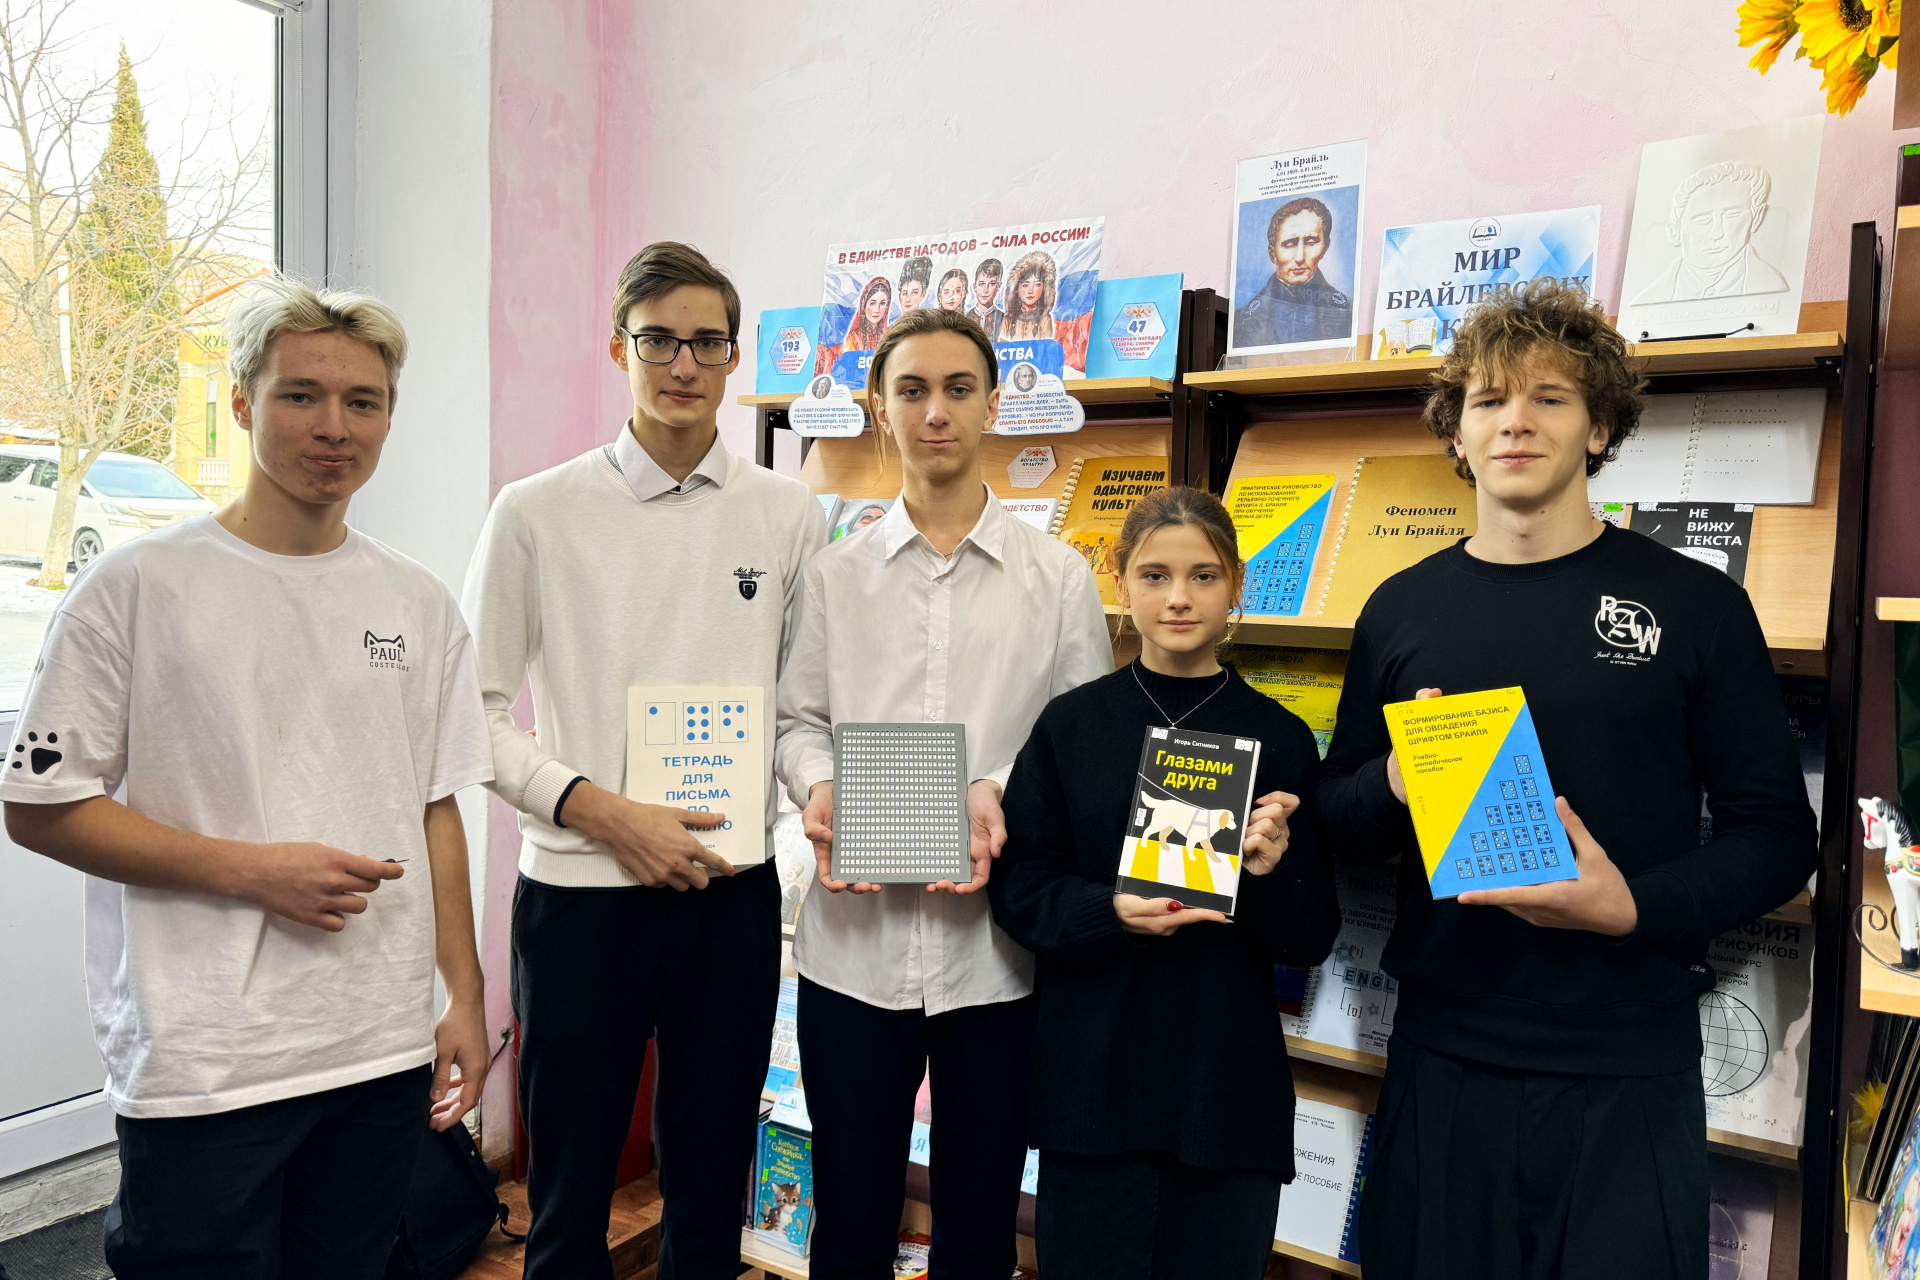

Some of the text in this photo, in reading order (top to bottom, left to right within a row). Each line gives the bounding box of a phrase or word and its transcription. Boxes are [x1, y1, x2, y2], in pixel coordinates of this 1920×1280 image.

[1271, 154, 1329, 171] Луи Брайль
[838, 252, 847, 264] В
[849, 246, 911, 265] ЕДИНСТВЕ
[992, 234, 1027, 248] СИЛА
[1031, 227, 1091, 245] РОССИИ!
[1453, 246, 1521, 273] МИР
[1129, 320, 1147, 333] 47
[782, 341, 800, 352] 193
[1102, 469, 1165, 482] Изучаем
[1092, 499, 1136, 511] культ
[1385, 505, 1457, 516] Феномен
[1688, 508, 1710, 519] НЕ
[1368, 525, 1465, 538] Луи Брайля
[1686, 522, 1735, 532] ВИЖУ
[1685, 535, 1743, 546] ТЕКСТА
[370, 647, 402, 662] PAUL
[1259, 654, 1304, 664] ГРАМОТА
[1403, 710, 1474, 726] ФОРМИРОВАНИЕ
[1475, 706, 1510, 716] БАЗИСА
[1405, 720, 1478, 737] ДЛЯ ОВЛАДЕНИЯ
[1408, 729, 1488, 745] ШРИФТОМ БРАЙЛЯ
[1174, 738, 1220, 750] Игорь Ситников
[661, 755, 733, 767] ТЕТРАДЬ
[1155, 750, 1234, 776] Глазами
[1413, 753, 1439, 761] Учебно-
[1414, 756, 1463, 767] методическое
[1416, 766, 1444, 774] пособие
[682, 773, 713, 786] ДЛЯ
[1163, 771, 1217, 791] друга
[665, 788, 730, 801] ПИСЬМА
[687, 805, 710, 813] ПО
[1348, 909, 1377, 920] ЗВУКАХ
[1379, 916, 1397, 924] АНГ
[1737, 921, 1801, 943] ФИЯ
[1716, 937, 1799, 960] РИСУНКОВ
[1738, 957, 1762, 967] КУРС
[1719, 976, 1748, 987] ВТОРОЙ
[1304, 1174, 1343, 1192] ПОСОБИЕ
